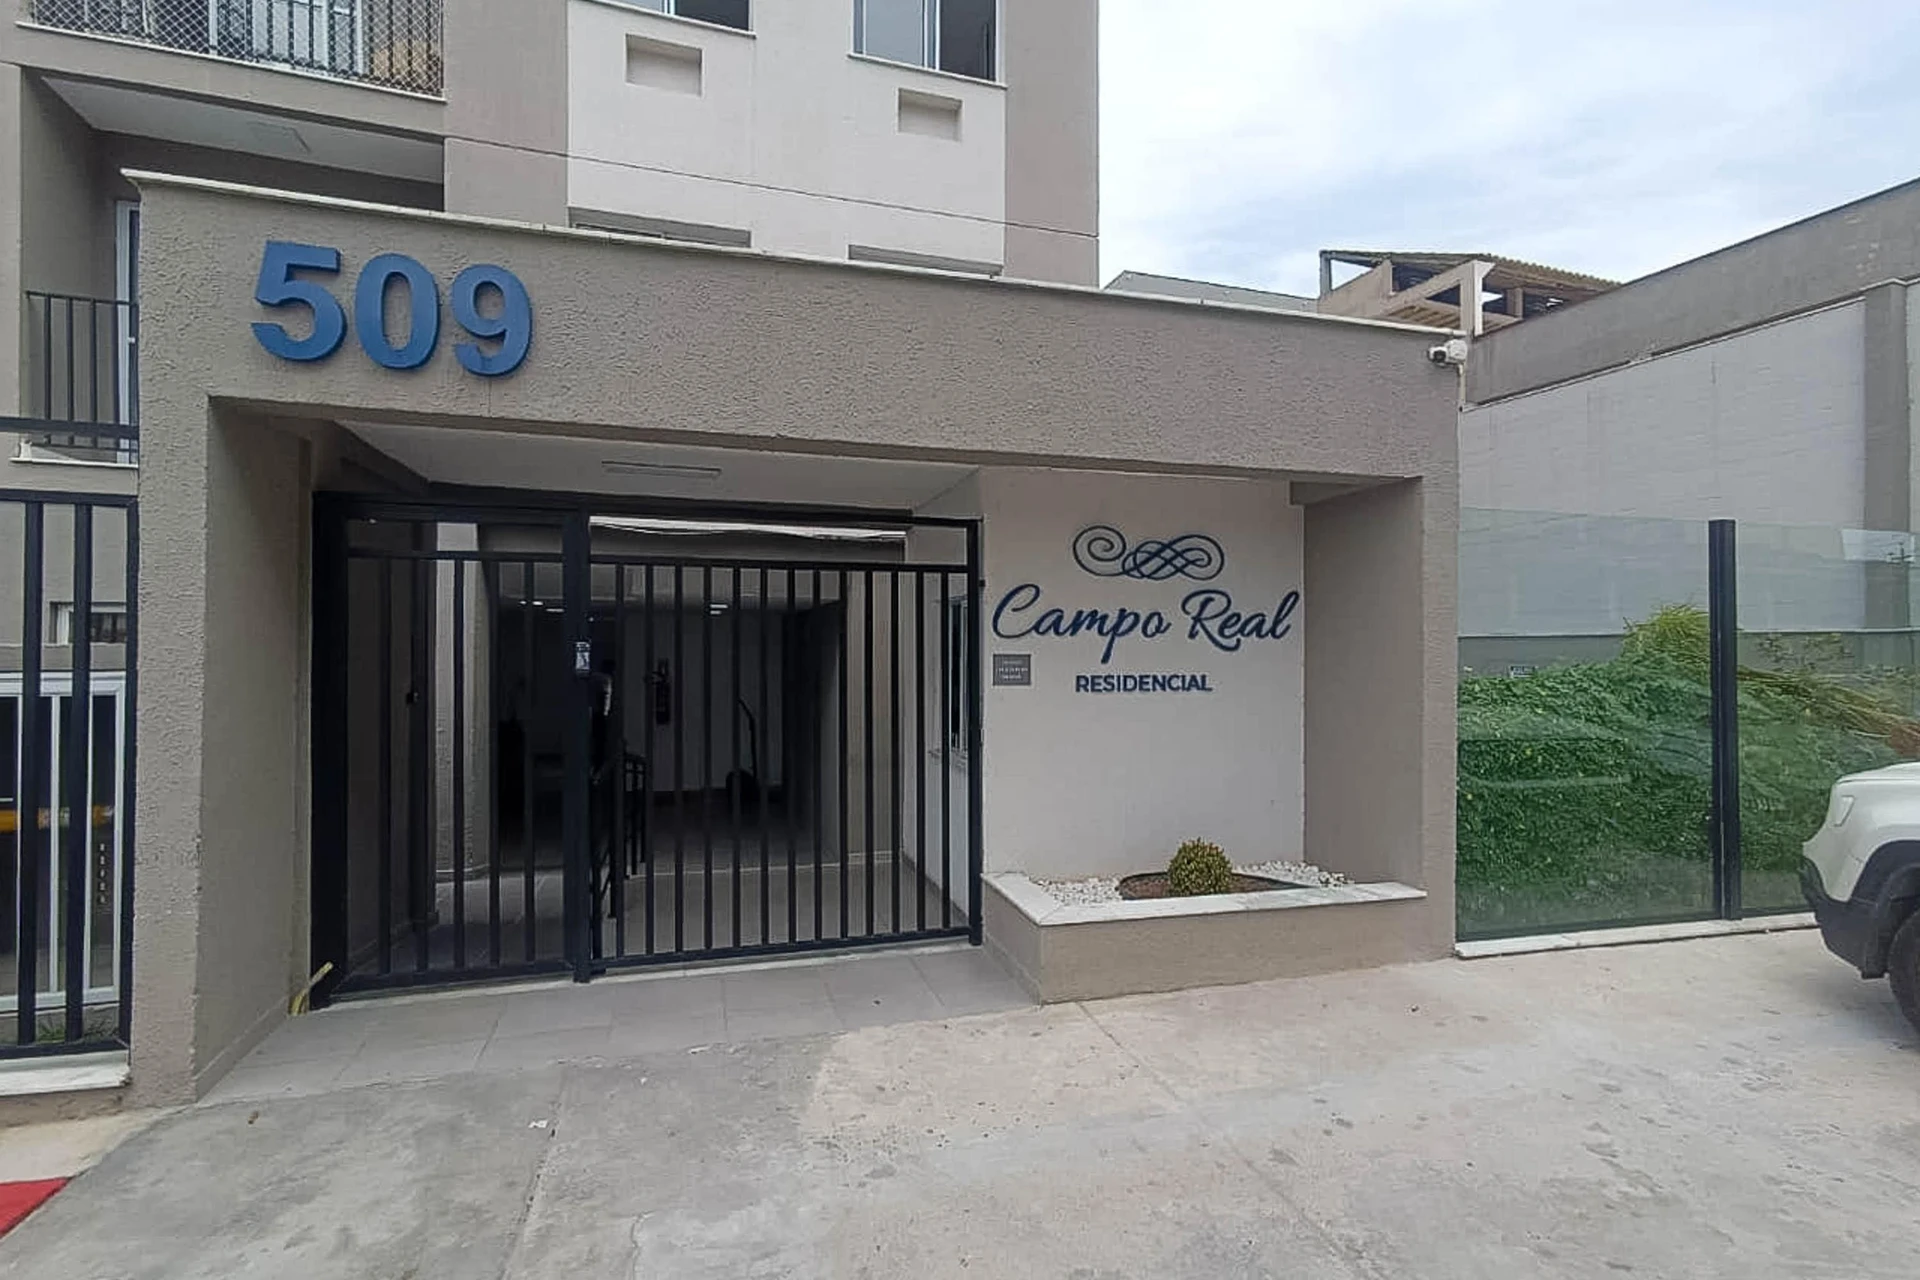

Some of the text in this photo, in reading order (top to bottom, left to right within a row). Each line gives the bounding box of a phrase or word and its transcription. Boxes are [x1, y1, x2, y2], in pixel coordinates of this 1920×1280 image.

[251, 240, 532, 376] 509
[992, 584, 1300, 664] Campo Real
[1075, 674, 1213, 693] RESIDENCIAL
